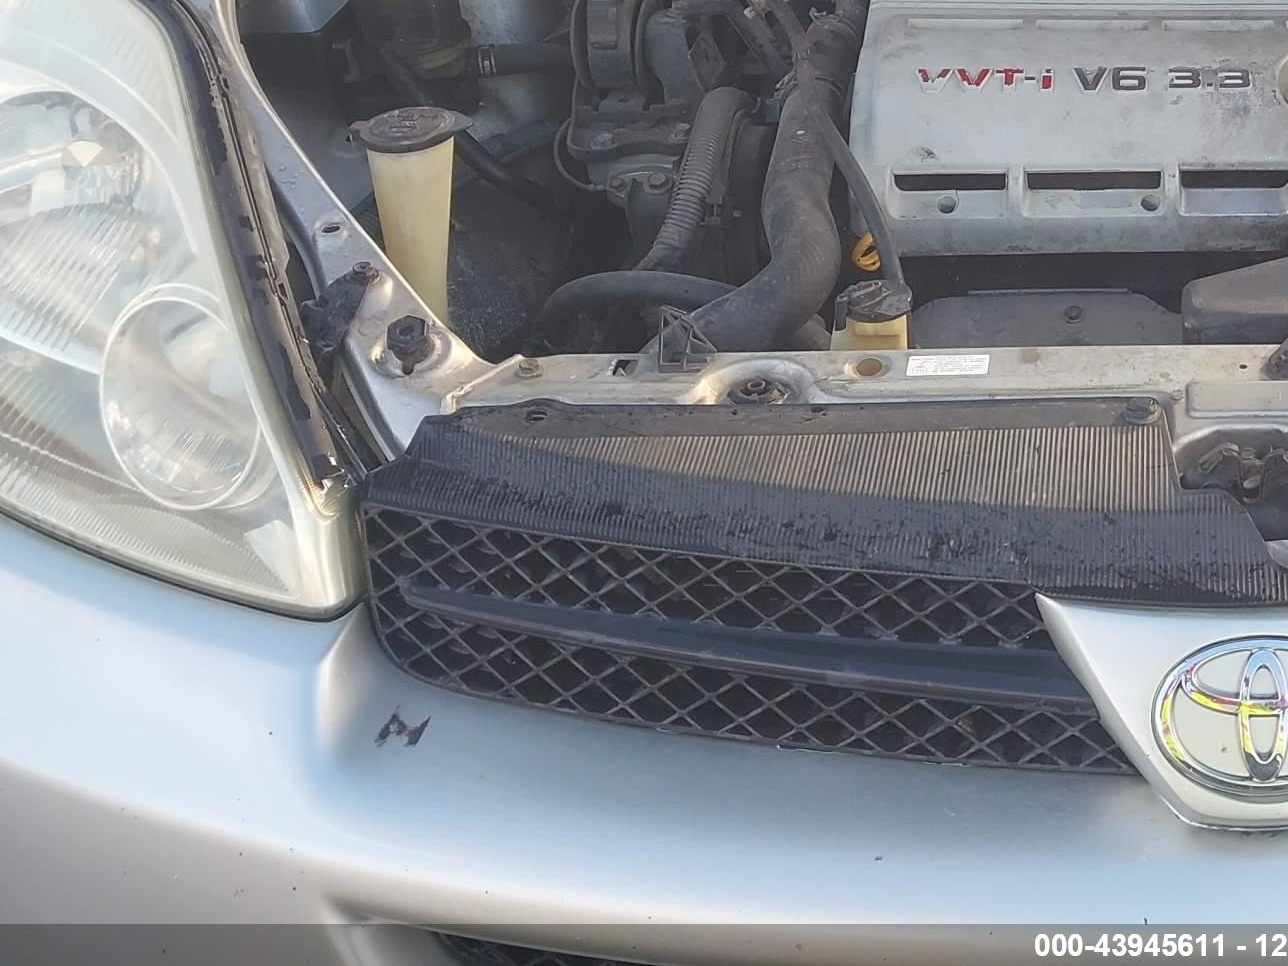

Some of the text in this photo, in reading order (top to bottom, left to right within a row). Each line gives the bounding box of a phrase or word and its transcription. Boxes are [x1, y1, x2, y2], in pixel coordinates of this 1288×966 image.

[918, 66, 1252, 92] VVT-i V6 3.3
